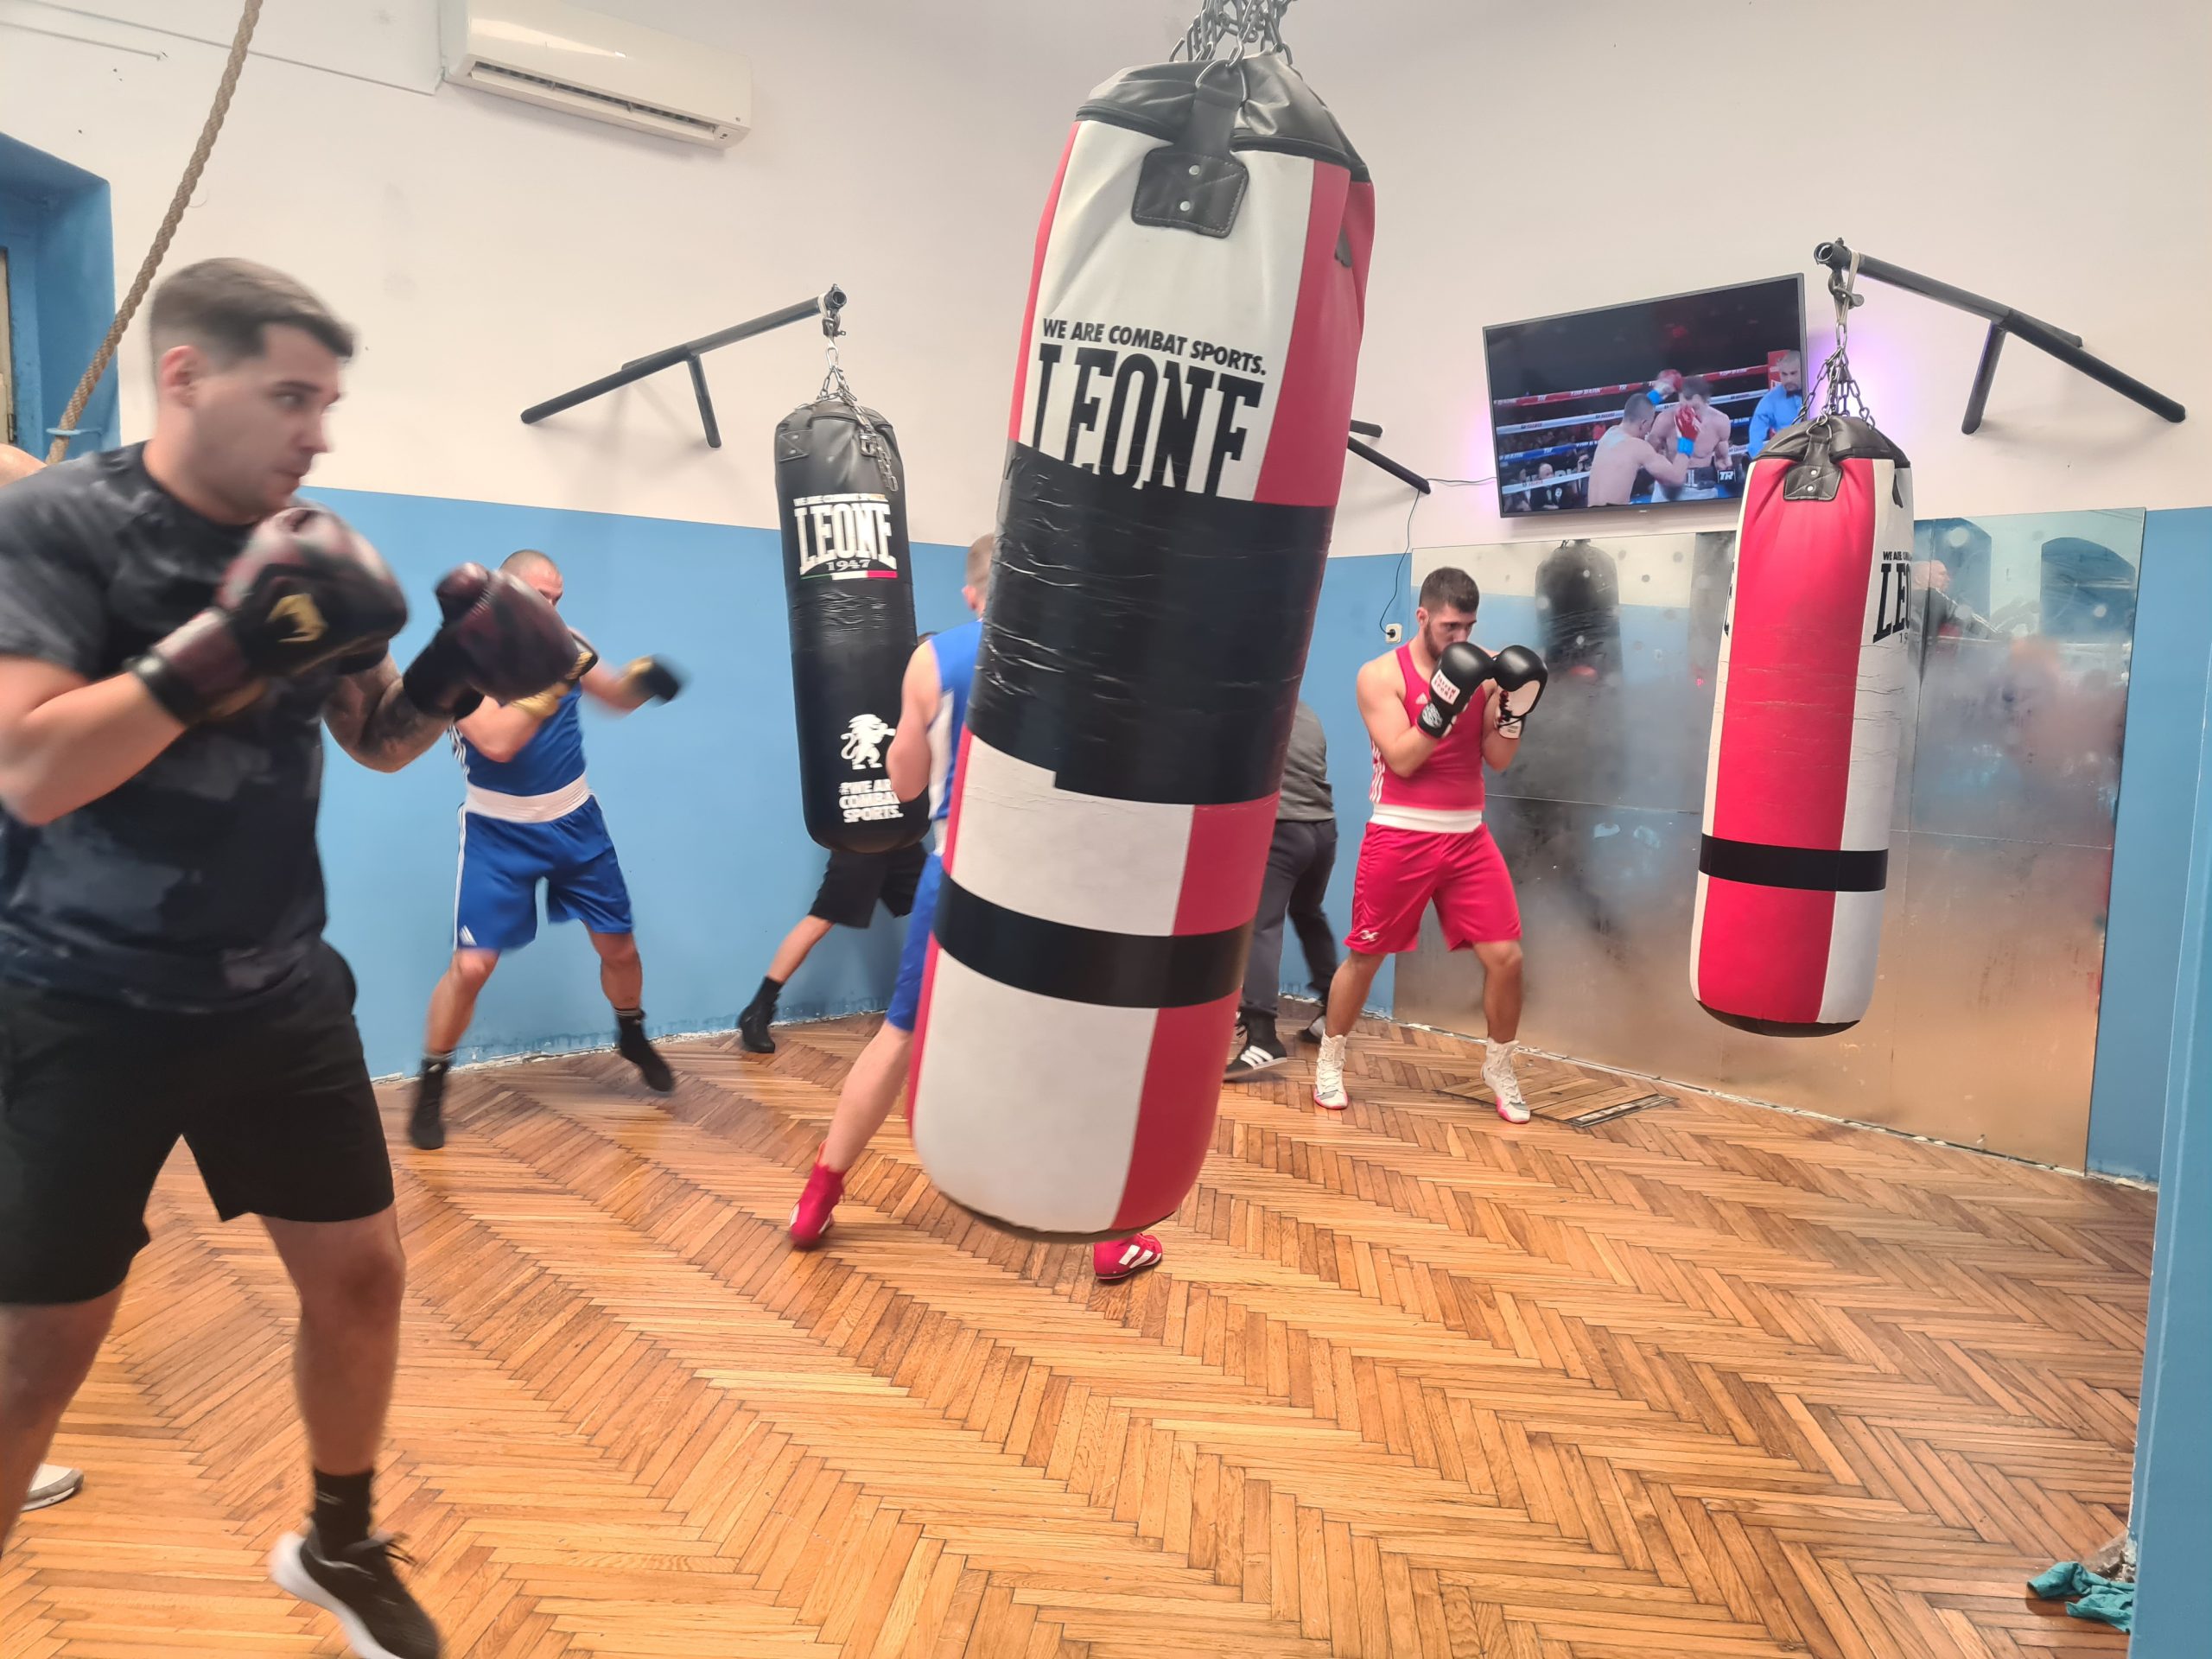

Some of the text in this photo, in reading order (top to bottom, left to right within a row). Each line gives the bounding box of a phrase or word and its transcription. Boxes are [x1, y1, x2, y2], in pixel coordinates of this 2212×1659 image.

[1043, 318, 1267, 376] WE ARE COMBAT SPORTS.
[1032, 342, 1265, 496] LEONE
[1719, 471, 1734, 480] TR
[793, 503, 897, 575] LEONE
[826, 559, 871, 572] 1947
[1872, 563, 1911, 644] LEO
